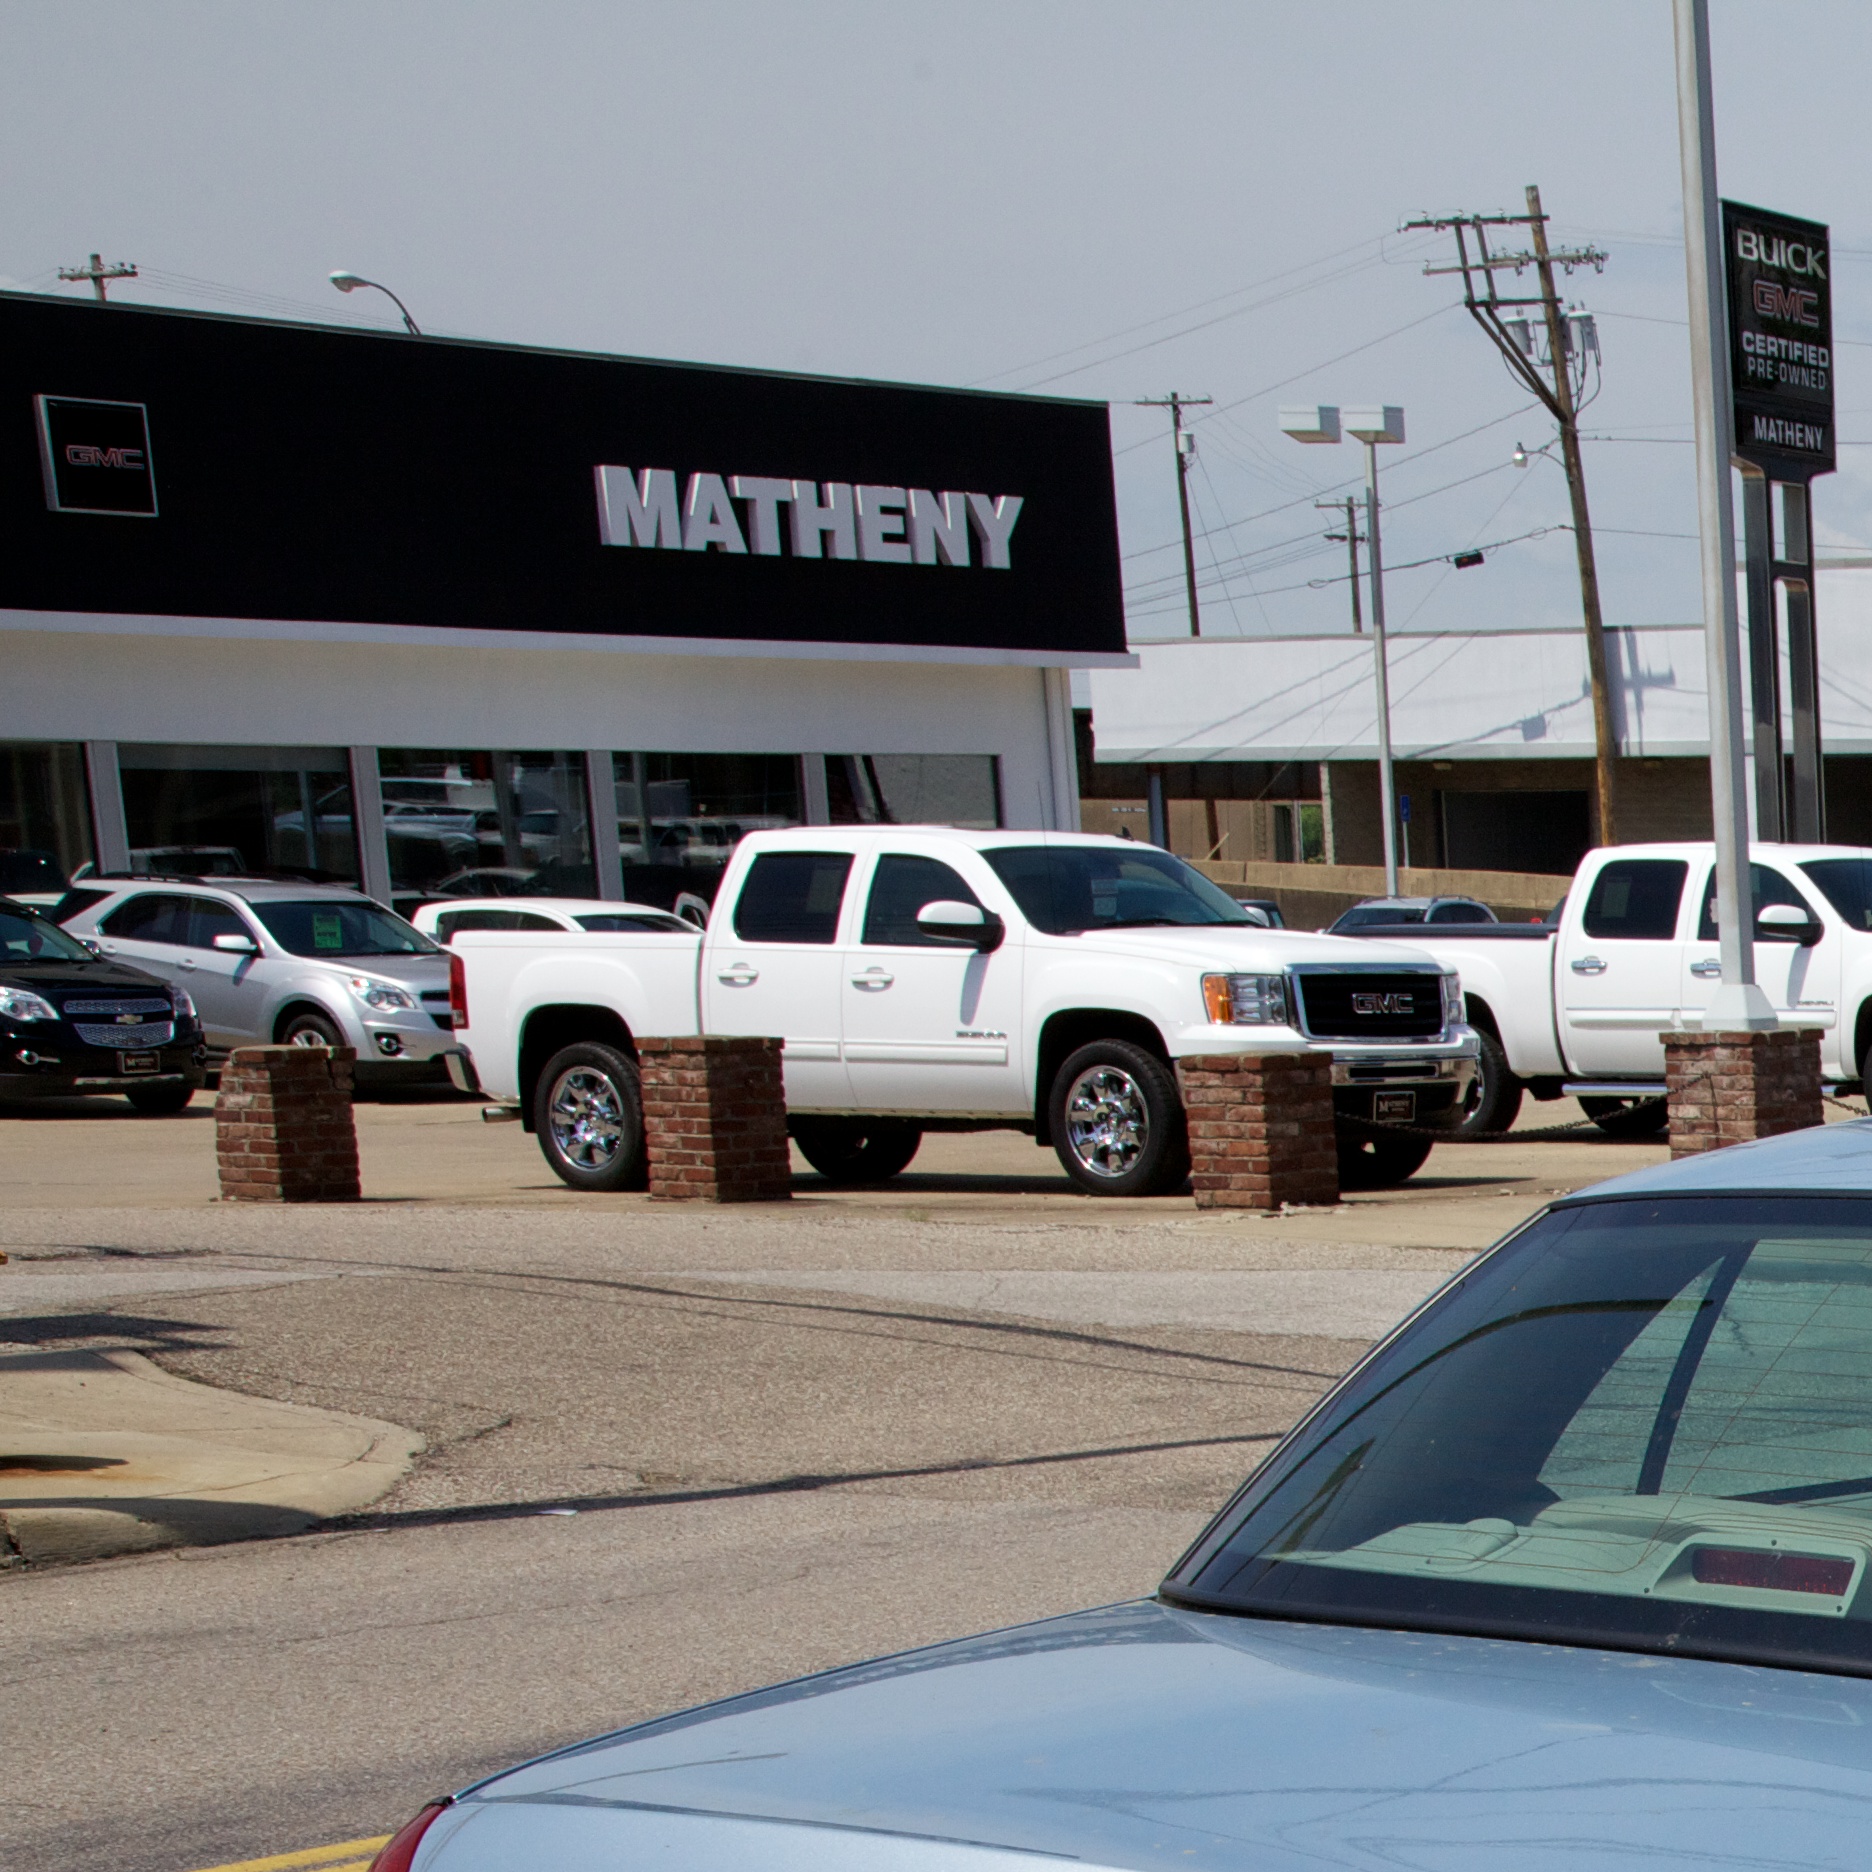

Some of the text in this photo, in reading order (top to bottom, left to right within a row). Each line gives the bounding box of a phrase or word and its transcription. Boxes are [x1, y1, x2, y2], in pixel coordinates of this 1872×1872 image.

[1736, 229, 1827, 280] BUICK
[1753, 279, 1820, 328] GMC
[1742, 331, 1830, 368] CERTIFIED
[1747, 356, 1827, 390] PRE-OWNED
[1753, 415, 1823, 450] MATHENY
[66, 444, 144, 470] GMC
[593, 465, 1024, 569] MATHENY
[1352, 993, 1414, 1014] GMC
